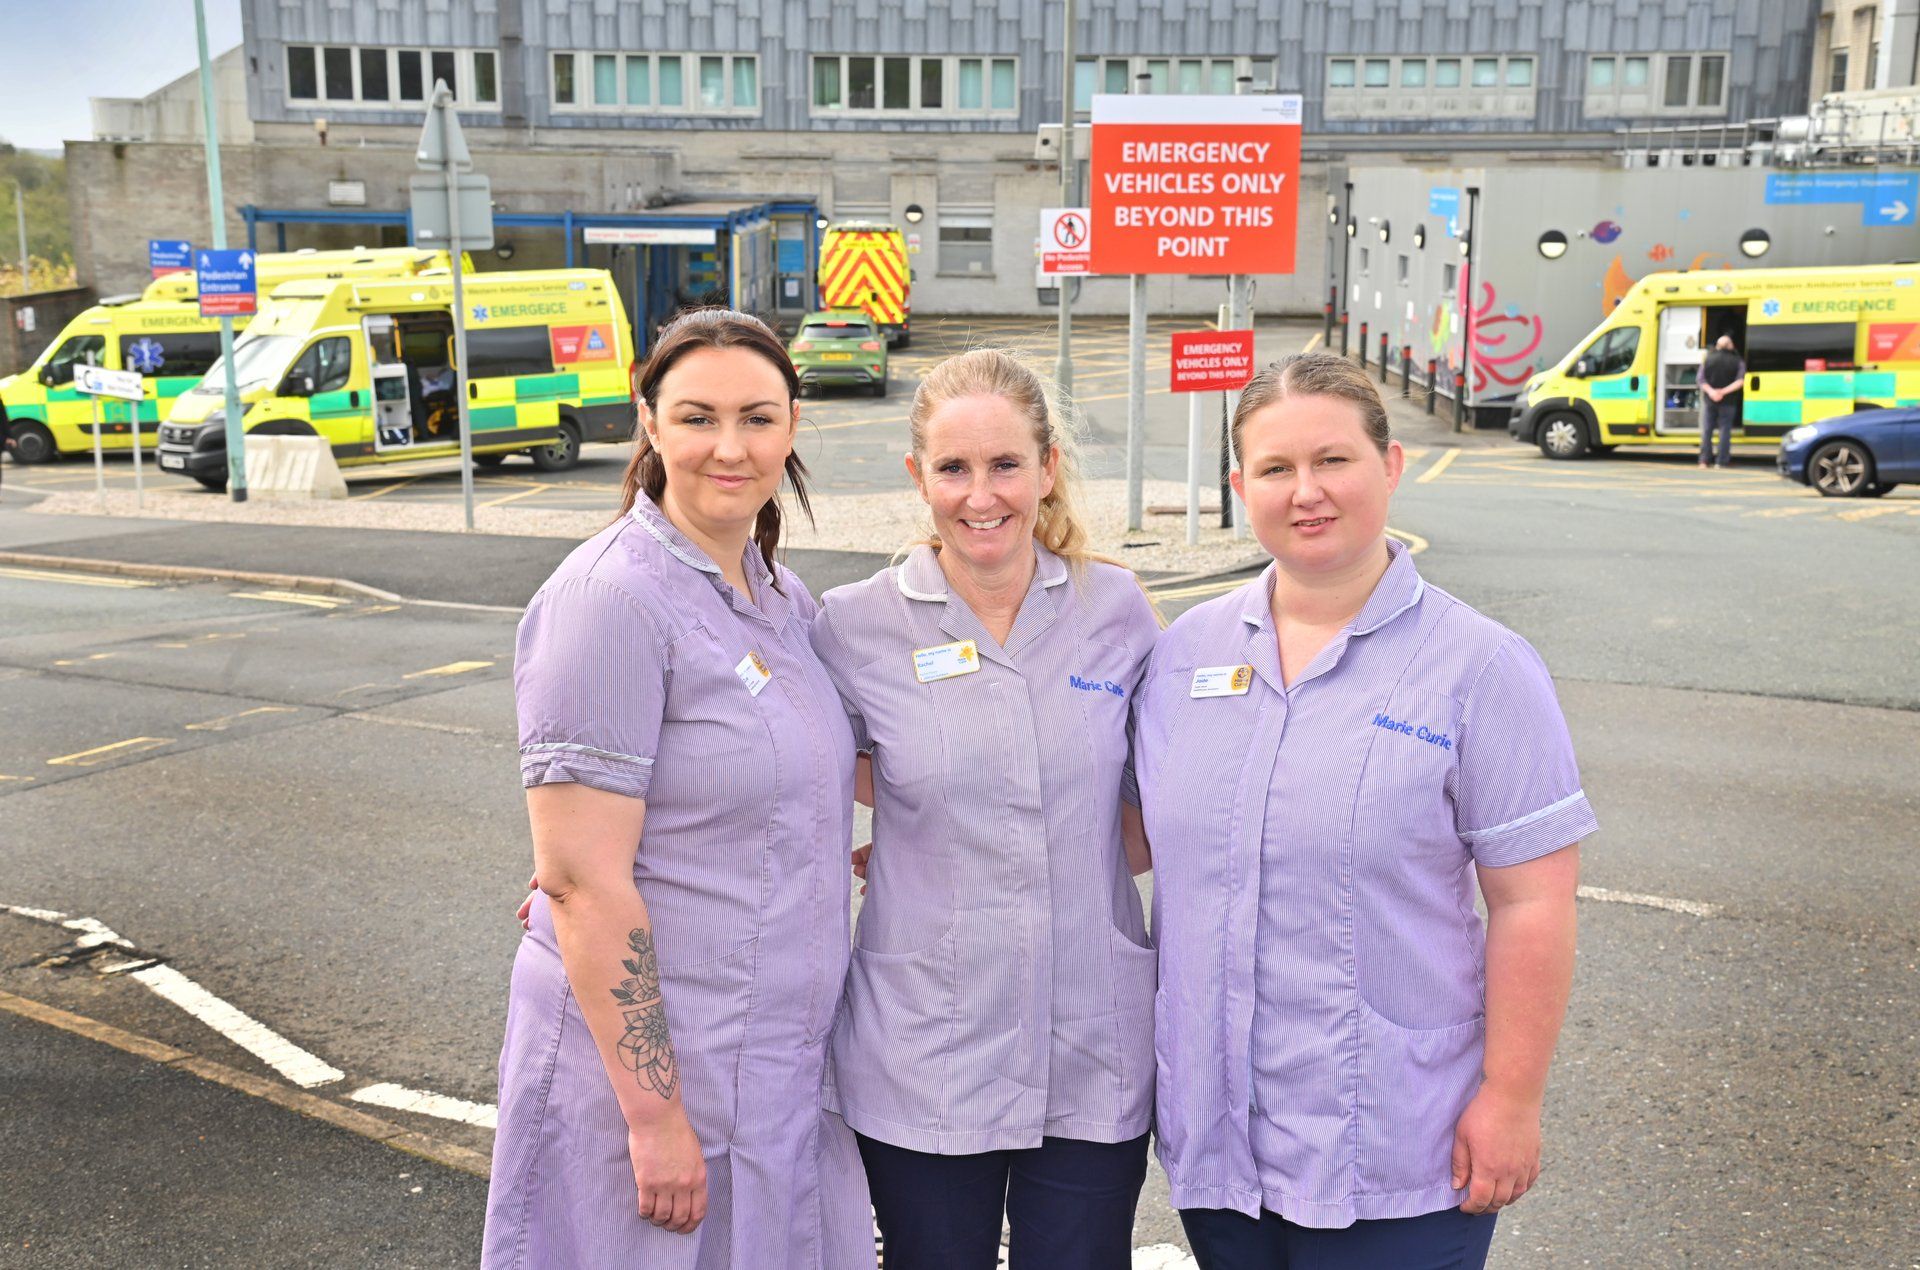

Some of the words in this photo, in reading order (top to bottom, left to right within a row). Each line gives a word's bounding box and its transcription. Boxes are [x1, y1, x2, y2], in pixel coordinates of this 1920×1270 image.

[1122, 142, 1271, 163] EMERGENCY
[1104, 173, 1215, 194] VEHICLES
[1221, 173, 1286, 194] ONLY
[1114, 206, 1215, 227] BEYOND
[1220, 206, 1274, 227] THIS
[1157, 236, 1230, 257] POINT
[200, 270, 248, 281] Pedestrian
[200, 282, 241, 293] Entrance
[1183, 342, 1243, 355] EMERGENCY
[1176, 357, 1221, 370] VEHICLES
[1222, 355, 1250, 367] ONLY
[1177, 371, 1208, 381] BEYOND
[1208, 370, 1225, 380] THIS
[1225, 368, 1249, 378] POINT
[1070, 675, 1103, 691] Marie
[1371, 713, 1414, 736] Marie
[1415, 726, 1452, 751] Curie
